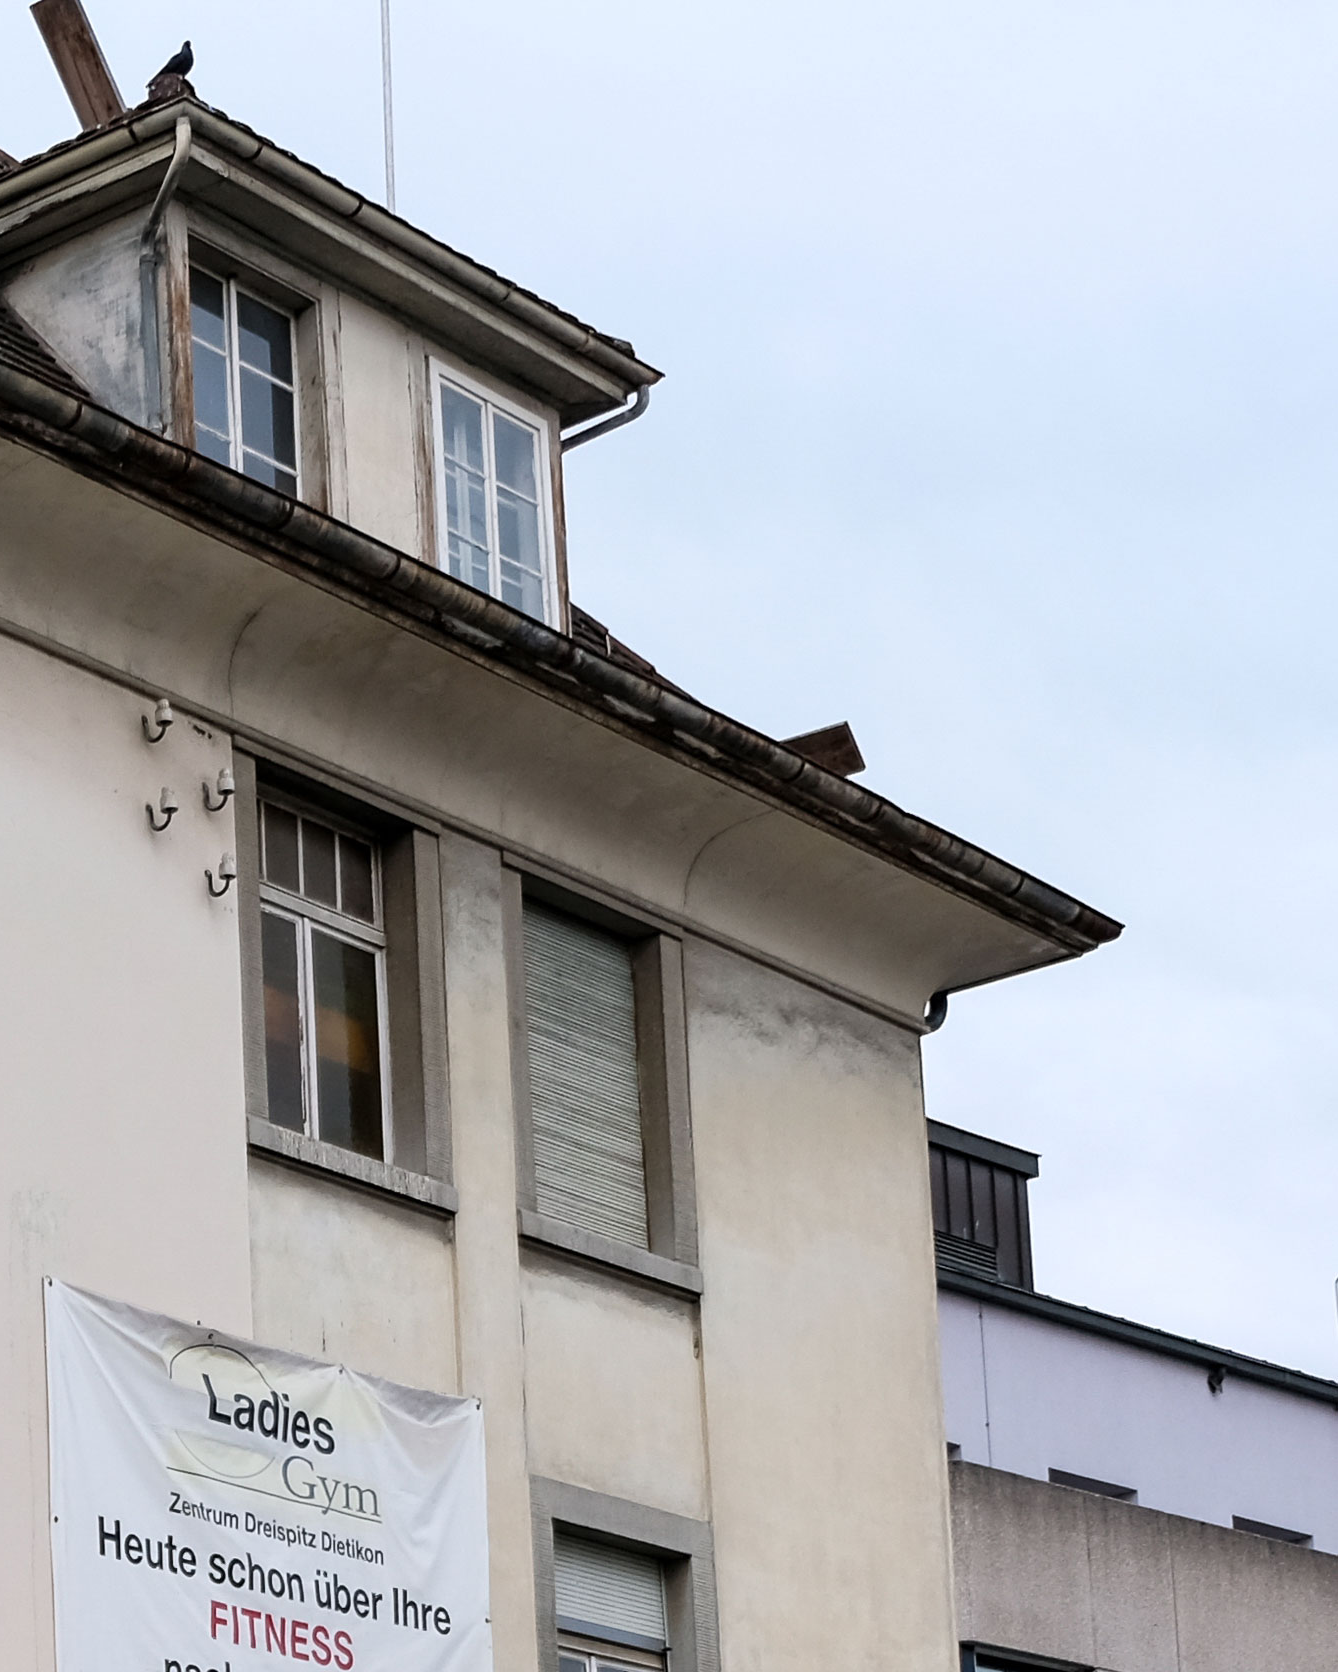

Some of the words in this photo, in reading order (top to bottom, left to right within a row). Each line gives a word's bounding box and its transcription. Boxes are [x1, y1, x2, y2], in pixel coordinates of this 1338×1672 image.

[203, 1372, 336, 1455] Ladies
[281, 1456, 382, 1517] Gym
[169, 1492, 239, 1531] Zentrum
[244, 1509, 317, 1550] Dreispitz
[321, 1531, 384, 1566] Dietikon
[98, 1515, 197, 1578] Heute
[208, 1553, 304, 1603] schon
[316, 1570, 382, 1620] über
[393, 1587, 451, 1636] Ihre
[211, 1601, 355, 1671] FITNESS
